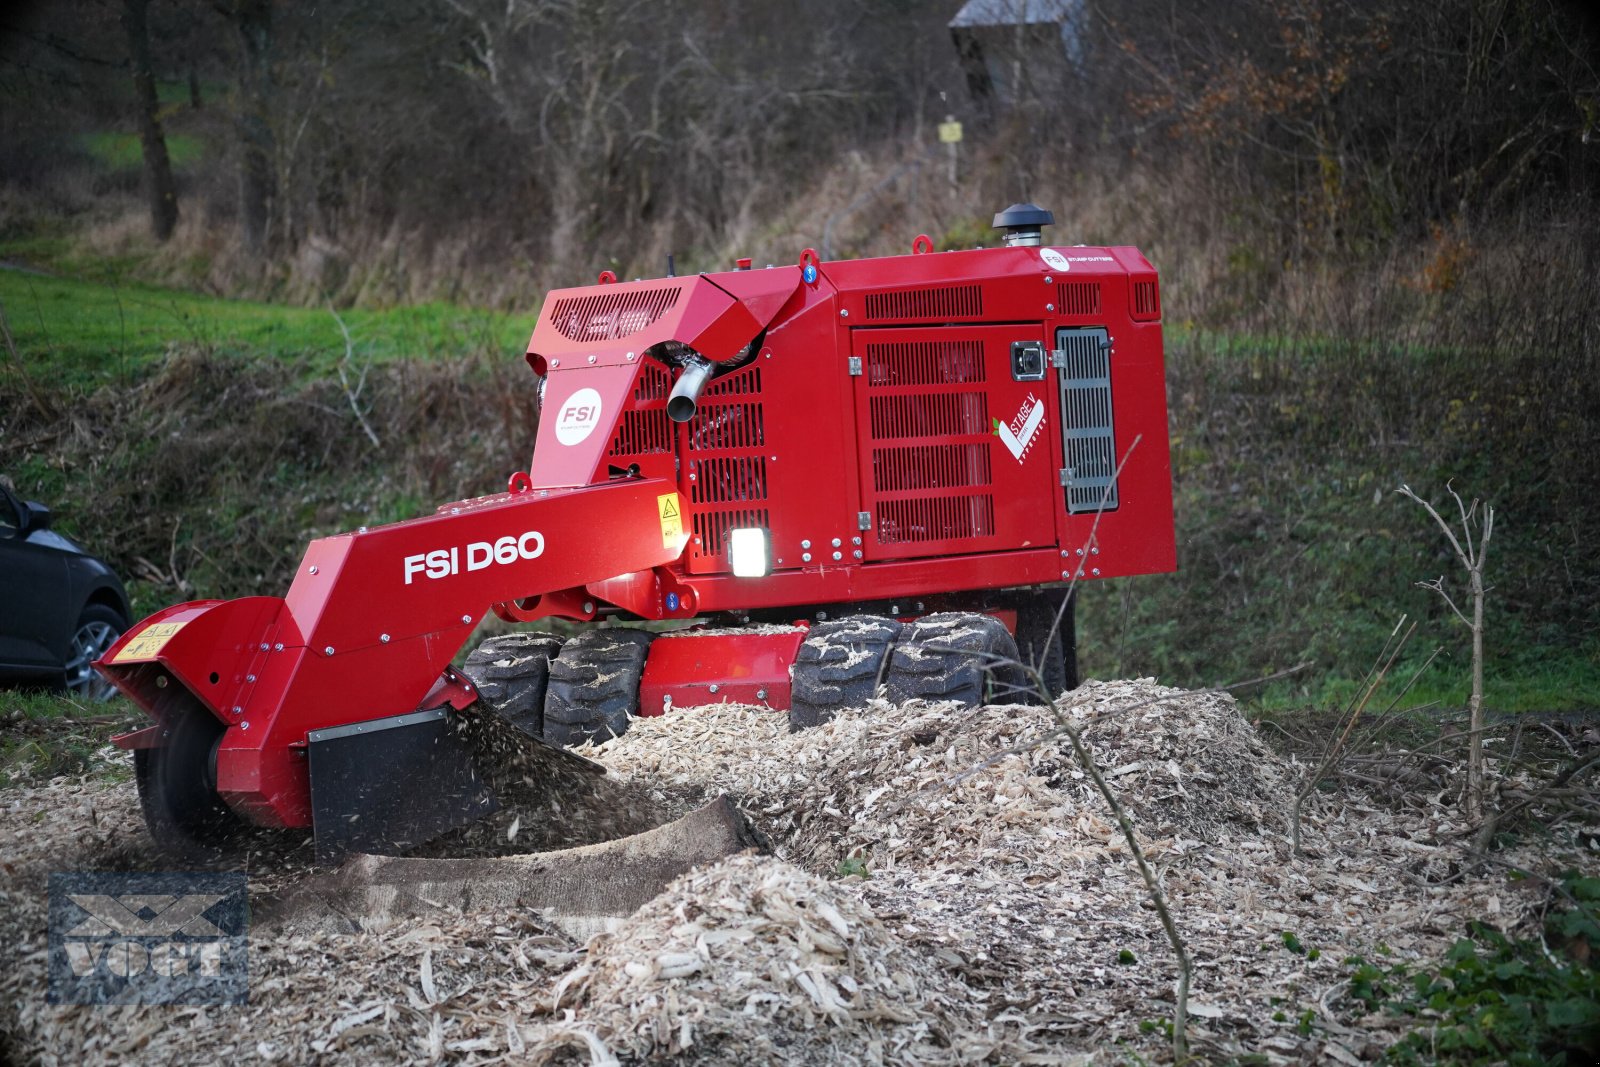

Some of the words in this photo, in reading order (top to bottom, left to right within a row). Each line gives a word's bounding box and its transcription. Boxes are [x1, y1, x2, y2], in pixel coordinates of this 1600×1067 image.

[563, 406, 596, 422] FSI
[1010, 400, 1032, 436] STAGE
[1027, 392, 1036, 404] V
[404, 546, 459, 585] FSI
[466, 530, 545, 572] D60
